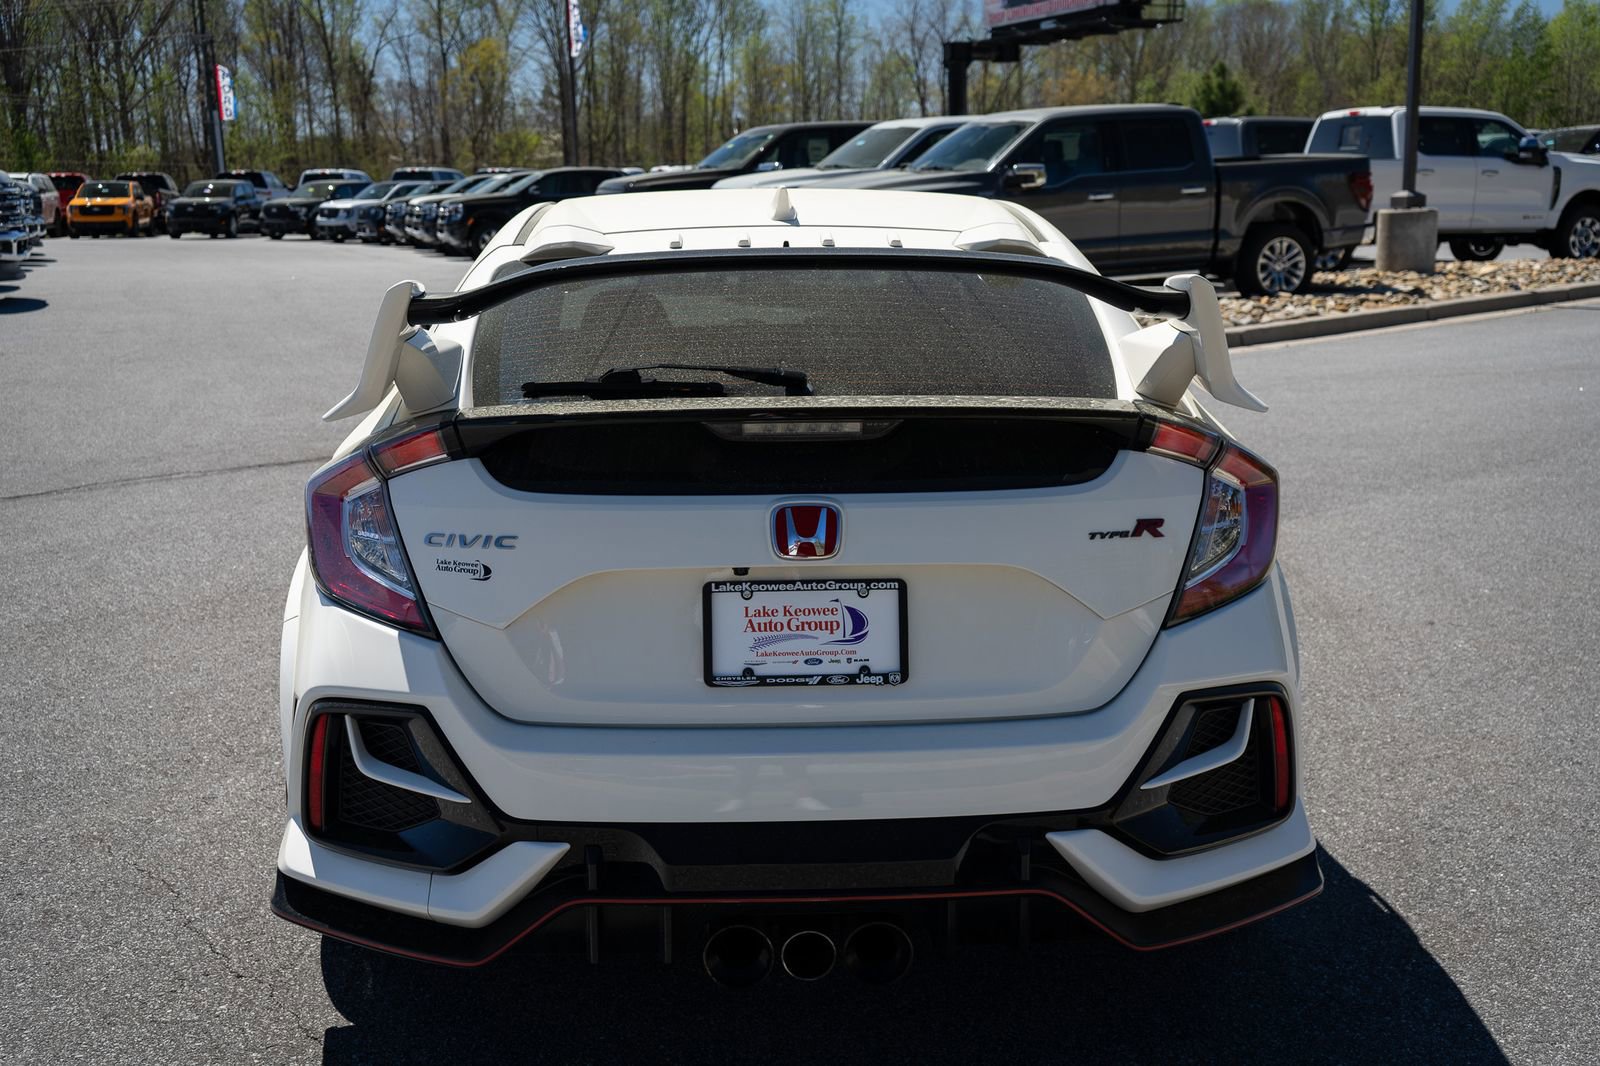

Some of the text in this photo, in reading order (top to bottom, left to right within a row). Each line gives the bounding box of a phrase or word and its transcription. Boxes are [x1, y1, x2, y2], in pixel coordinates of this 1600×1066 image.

[1088, 518, 1165, 540] TYPE R
[423, 532, 519, 550] CIVIC
[452, 560, 479, 568] Keowee
[435, 565, 479, 576] Auto Group
[711, 581, 899, 592] LakeKeoweeAutoGroup.com
[744, 605, 839, 618] Lake Keowee
[743, 618, 841, 634] Auto Group
[755, 649, 857, 658] LakeKeoweeAutoGroup.Com
[828, 676, 847, 684] Ford
[856, 673, 884, 685] Jeep
